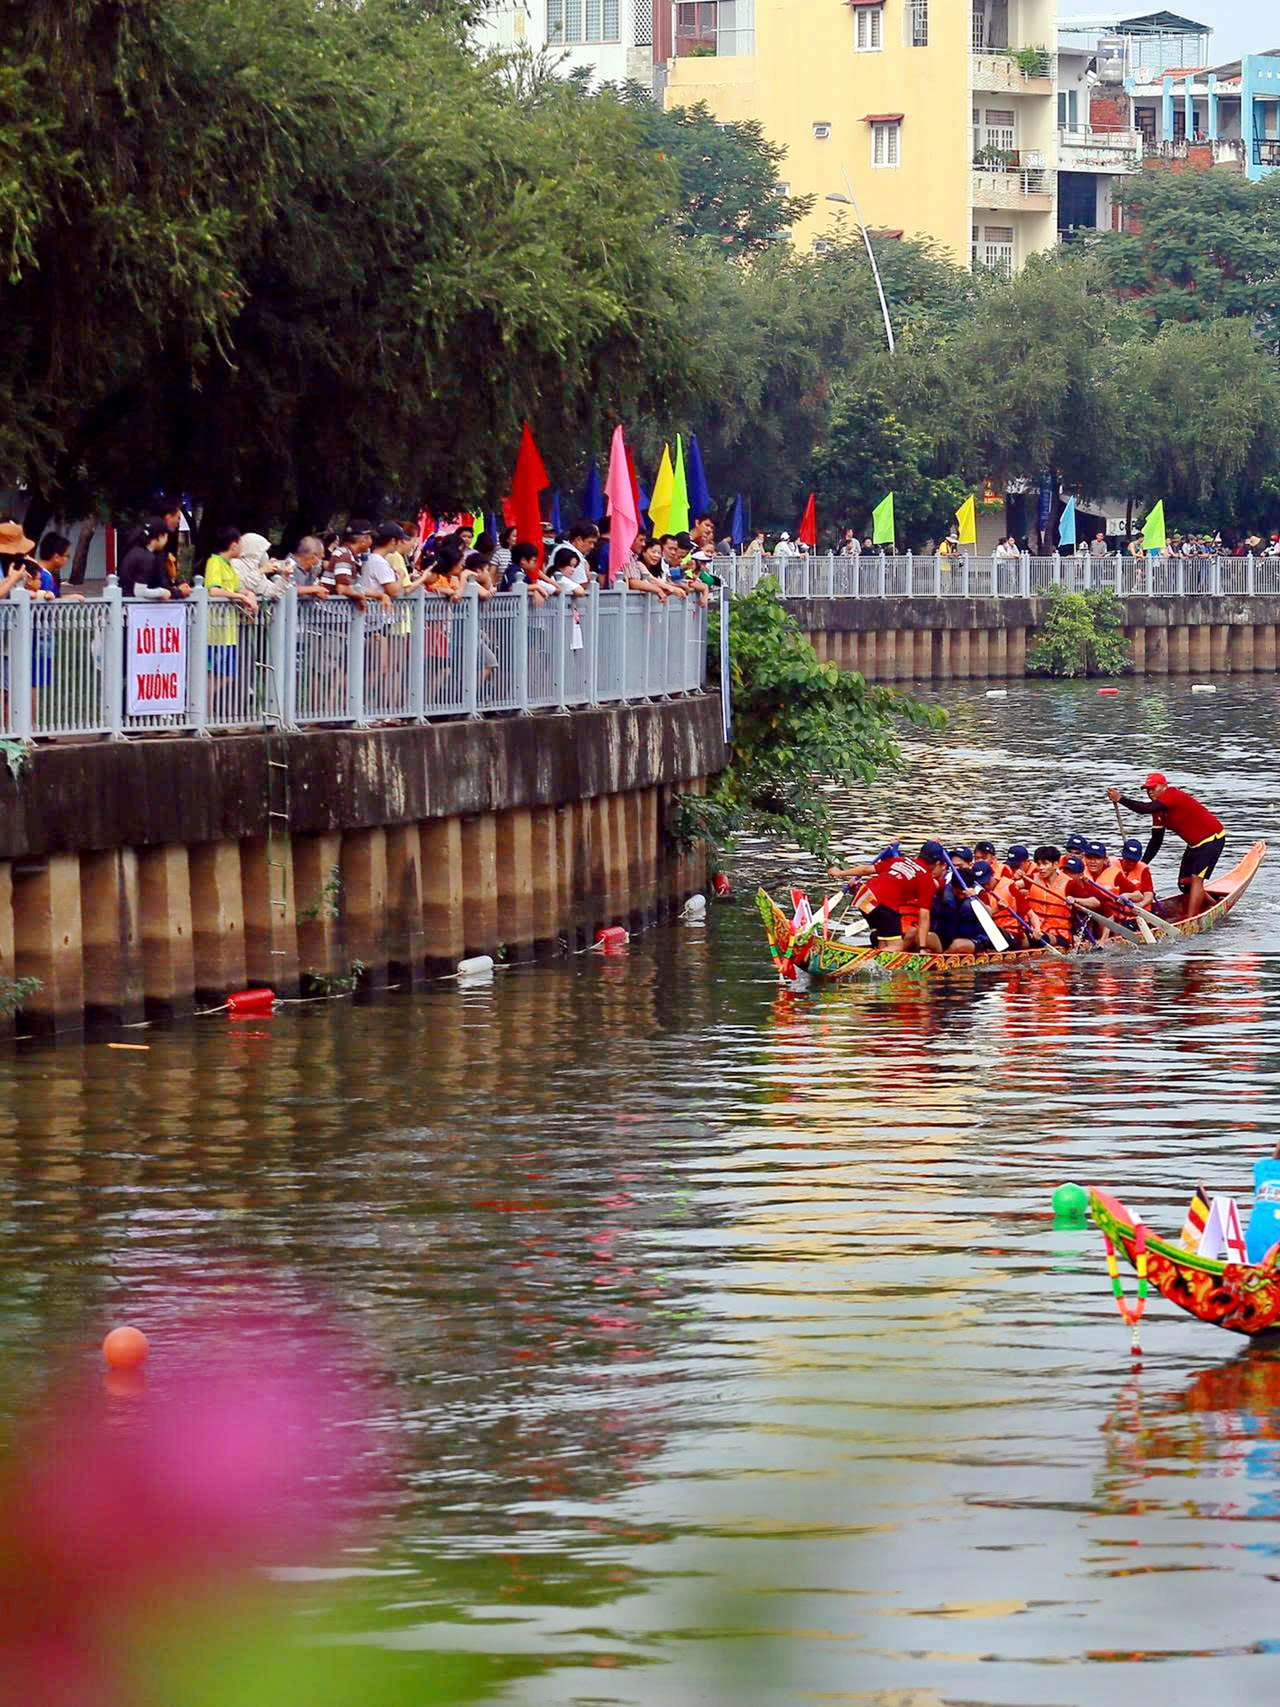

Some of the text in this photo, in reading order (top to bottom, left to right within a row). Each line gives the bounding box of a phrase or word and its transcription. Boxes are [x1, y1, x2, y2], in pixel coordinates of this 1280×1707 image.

[160, 622, 179, 653] LÊN
[137, 665, 178, 700] XUỐNG
[1227, 1199, 1246, 1263] 4
